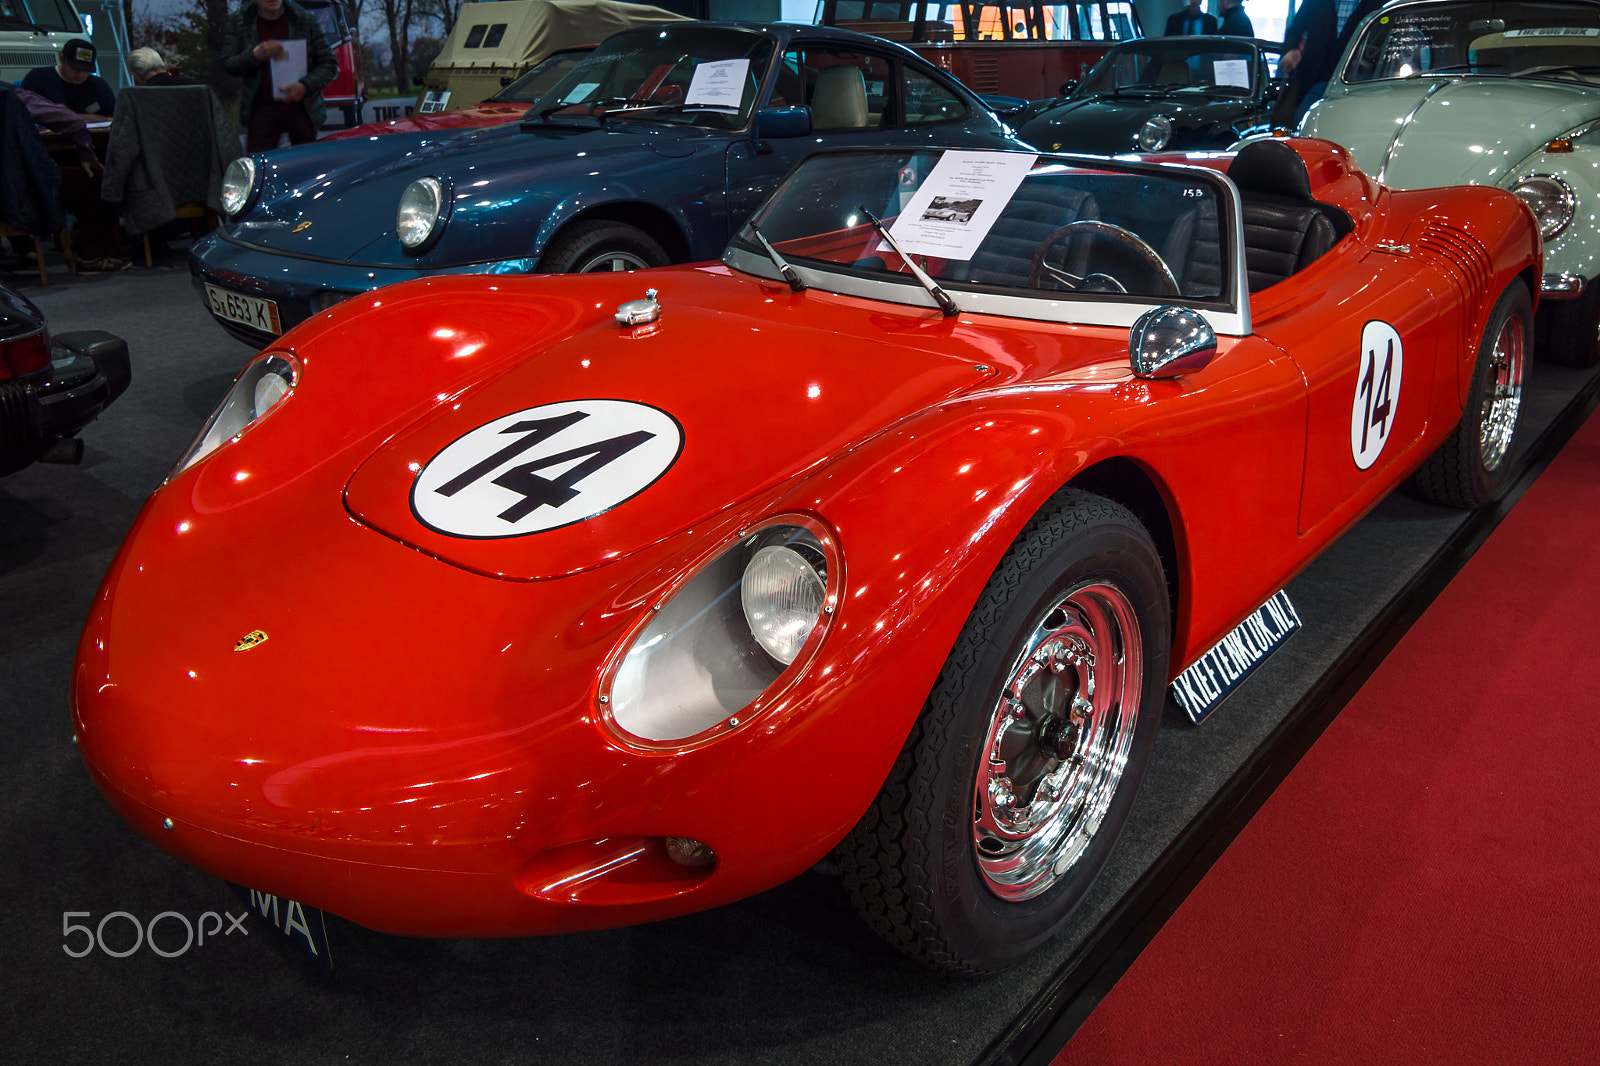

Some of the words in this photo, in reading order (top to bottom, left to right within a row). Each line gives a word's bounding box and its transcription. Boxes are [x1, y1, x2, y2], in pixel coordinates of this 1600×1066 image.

[373, 106, 401, 122] THE
[1360, 338, 1393, 454] 14
[433, 410, 657, 524] 14
